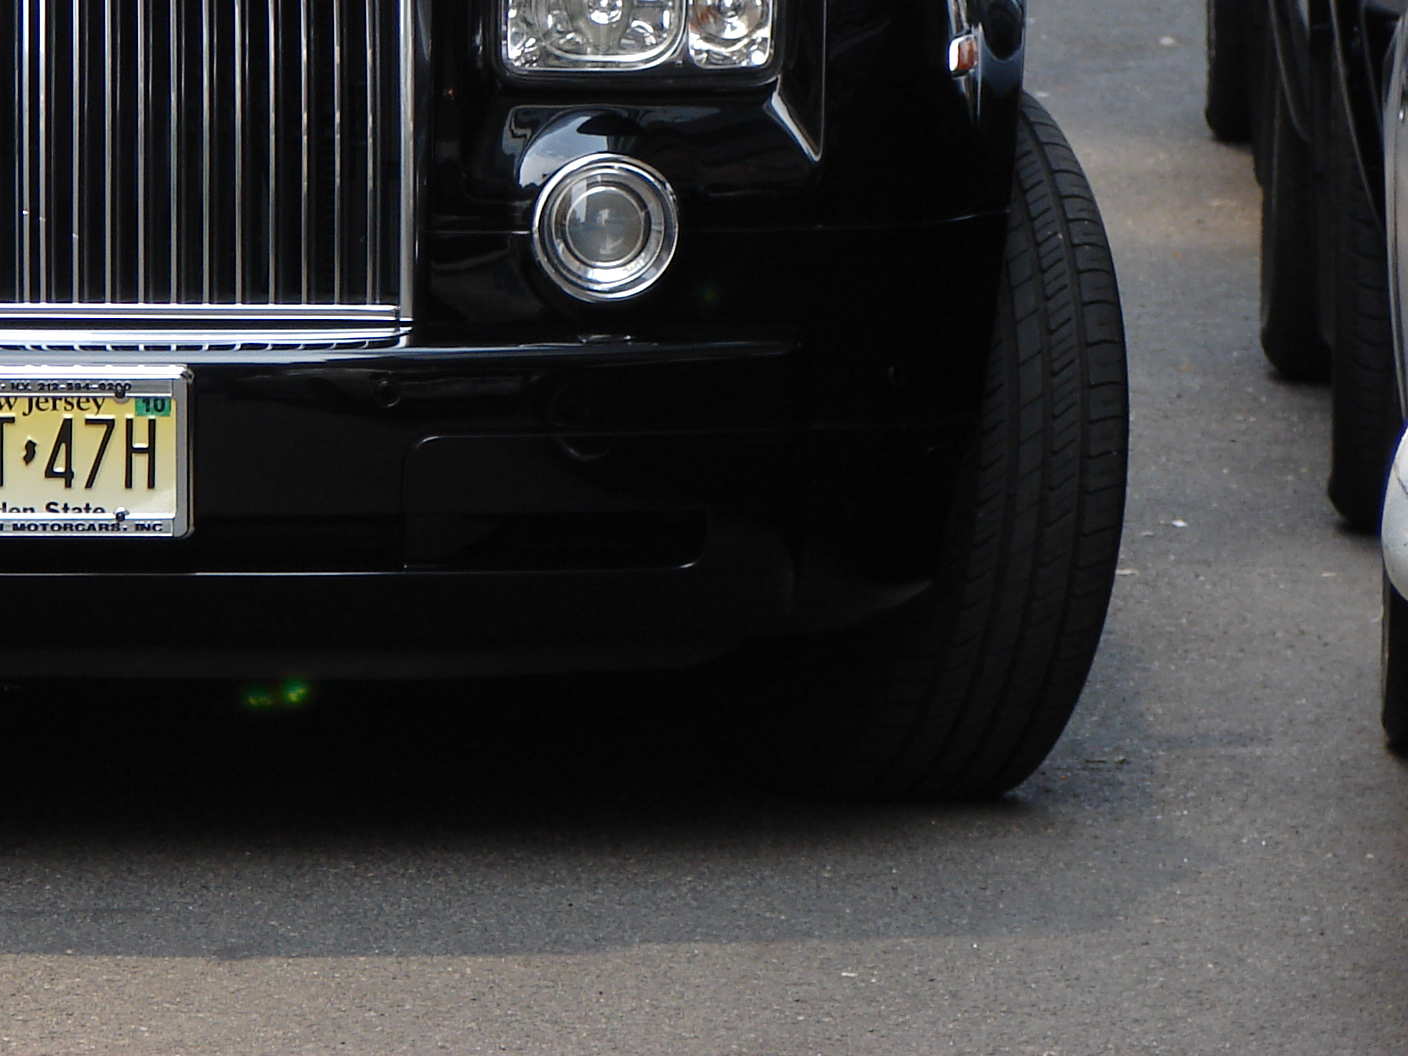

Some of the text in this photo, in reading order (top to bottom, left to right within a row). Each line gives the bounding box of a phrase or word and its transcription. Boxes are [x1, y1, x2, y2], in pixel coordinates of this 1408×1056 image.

[22, 396, 106, 416] Jersey
[143, 397, 166, 413] 10
[44, 416, 157, 490] 47H
